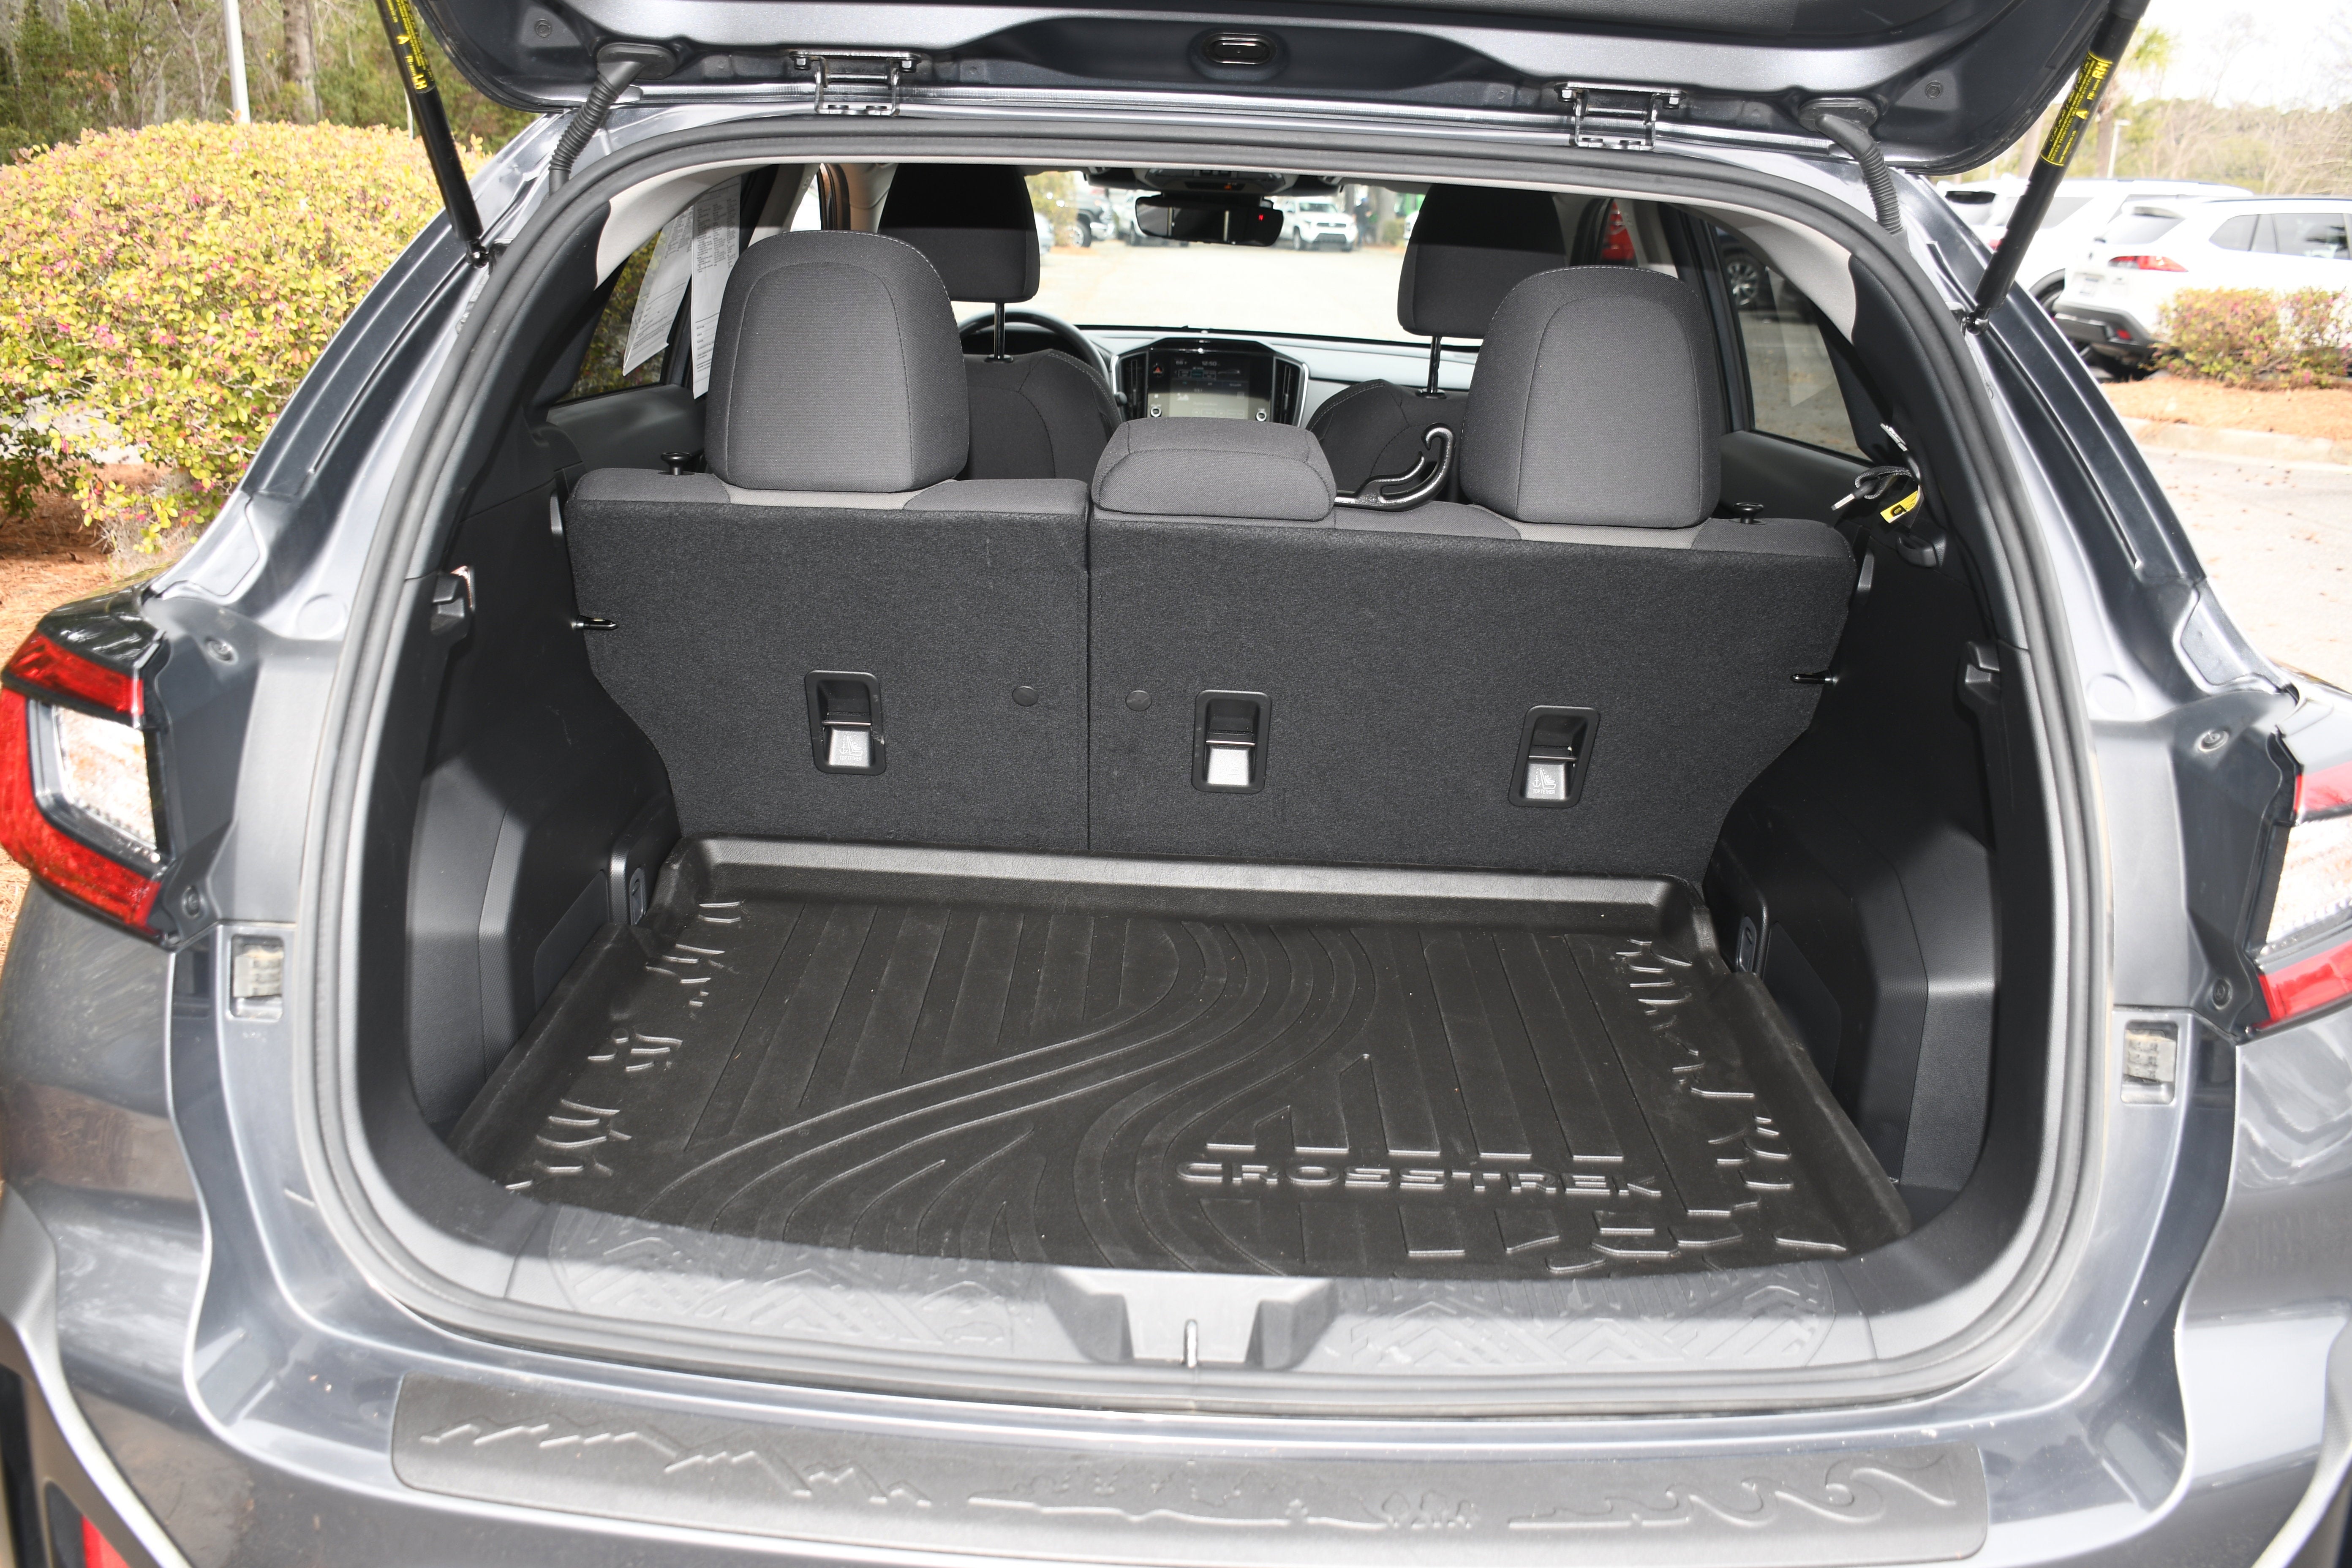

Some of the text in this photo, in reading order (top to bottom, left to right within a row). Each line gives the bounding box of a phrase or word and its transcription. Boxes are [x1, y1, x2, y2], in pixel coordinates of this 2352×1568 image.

[2091, 62, 2110, 79] RH
[412, 74, 428, 90] LH
[2076, 110, 2088, 120] A
[1176, 1162, 1662, 1196] CROSSTREK
